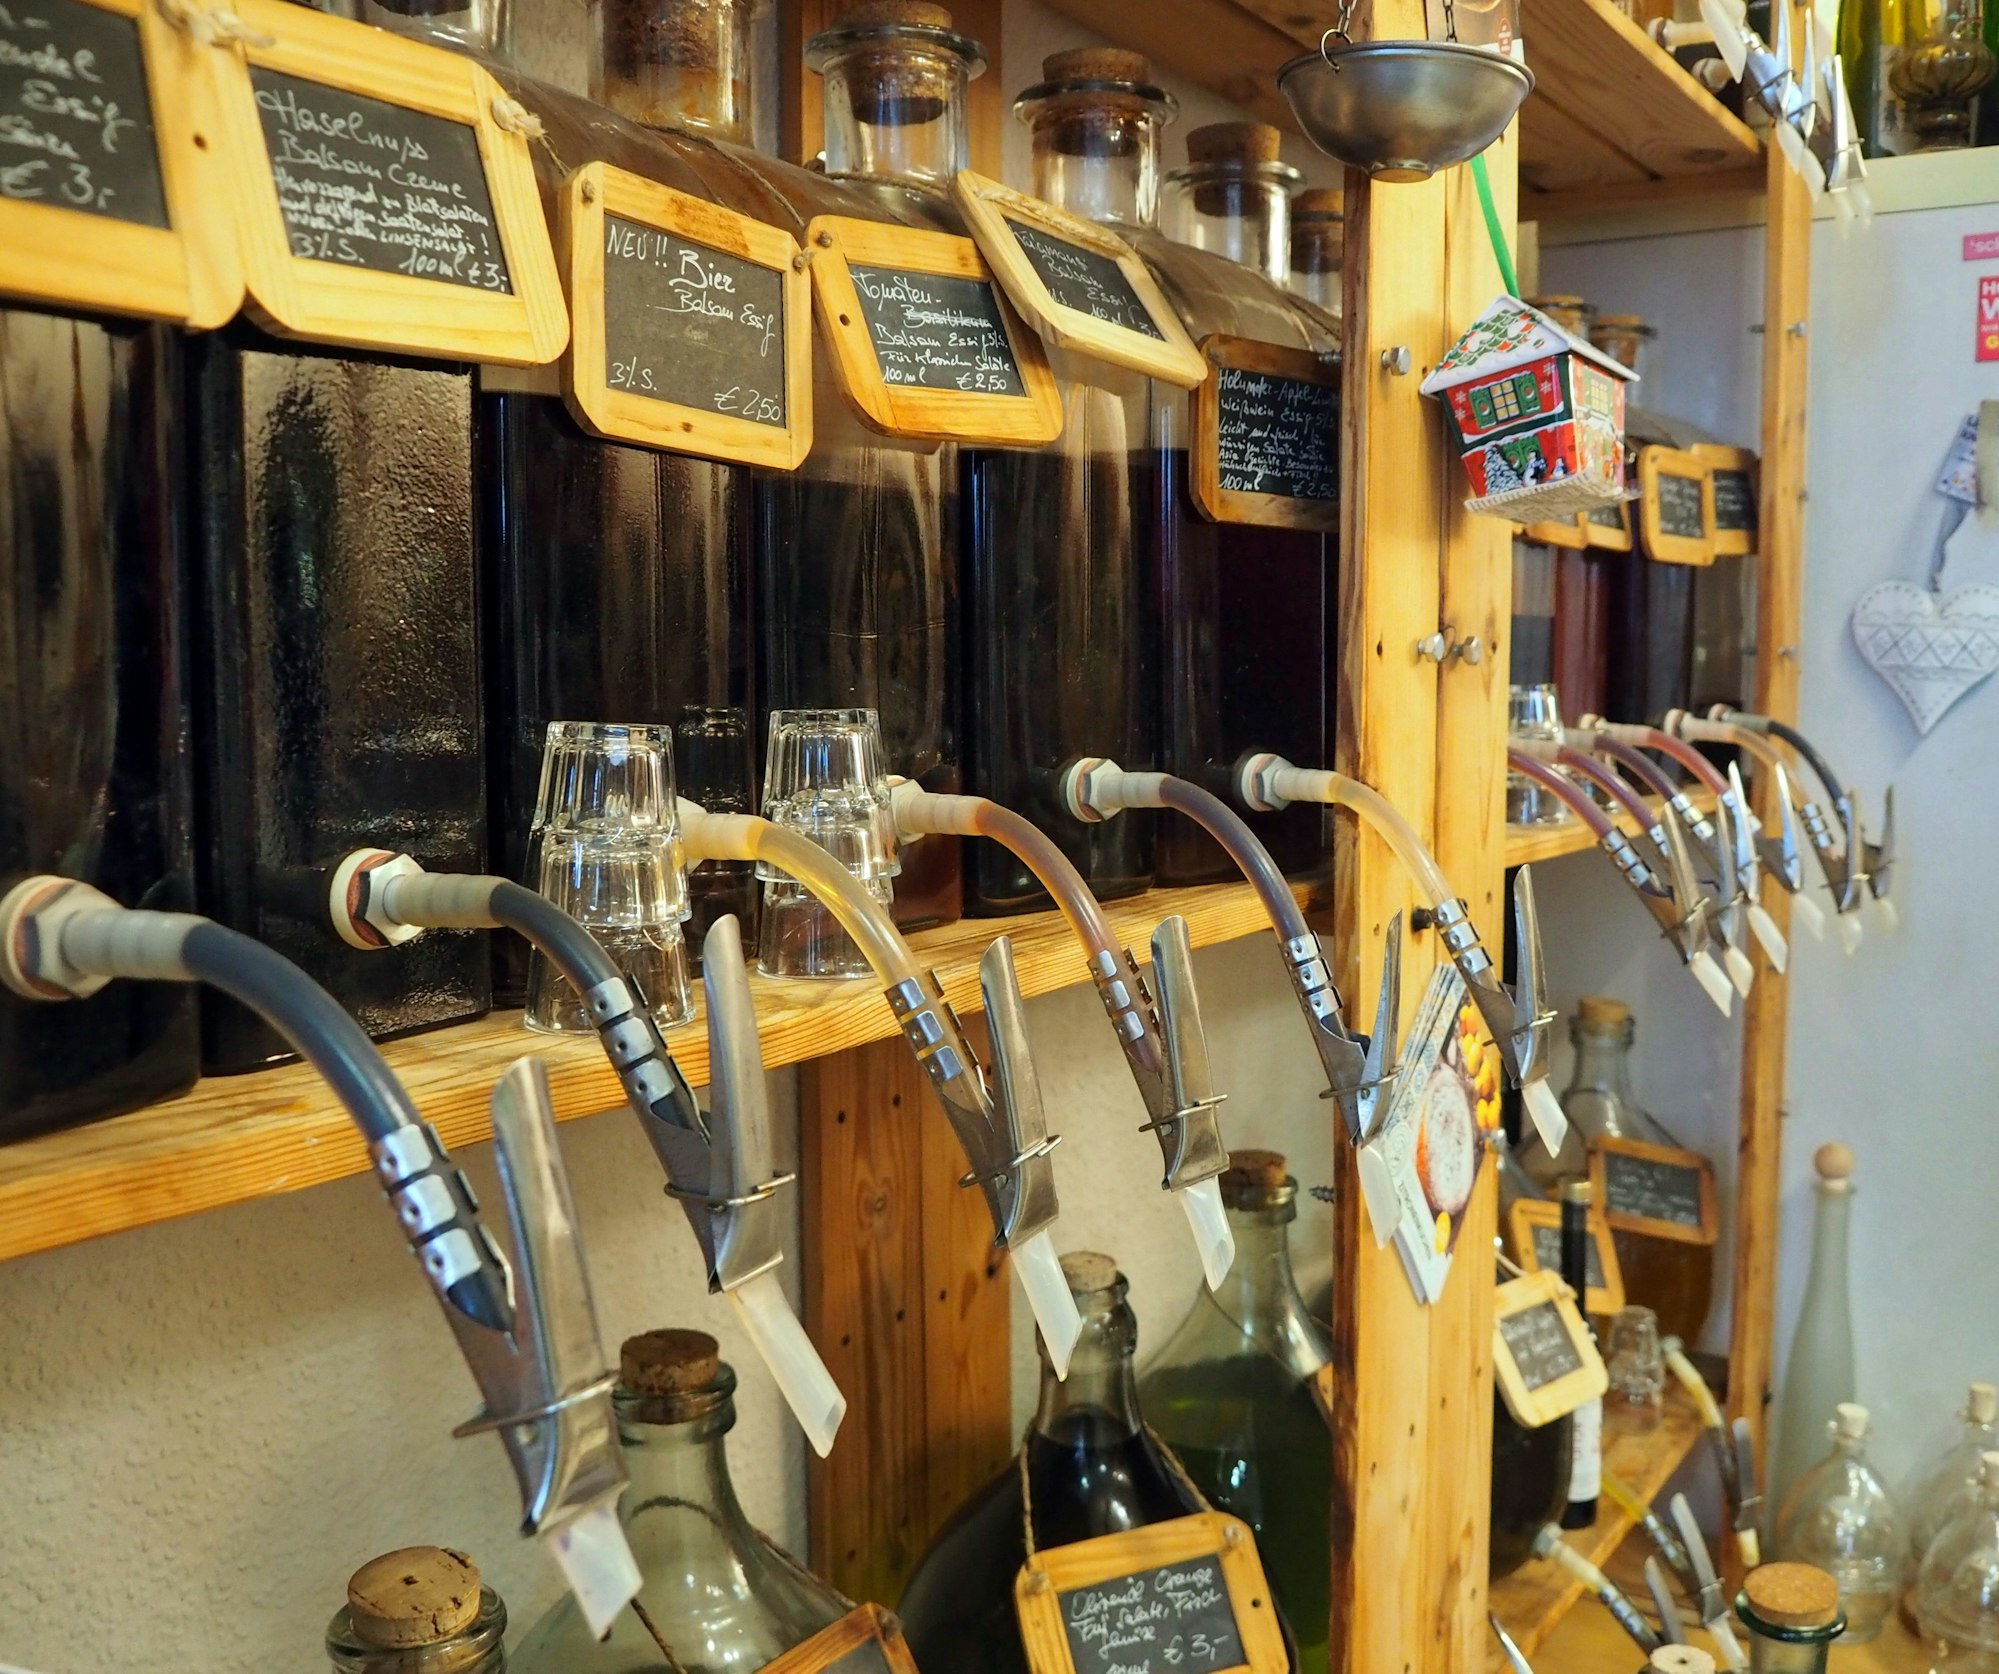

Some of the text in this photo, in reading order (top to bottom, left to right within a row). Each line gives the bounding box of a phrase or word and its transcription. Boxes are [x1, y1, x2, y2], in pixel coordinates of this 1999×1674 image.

[275, 129, 382, 180] Balsam
[669, 249, 736, 294] Bier
[658, 288, 734, 320] Balsam
[875, 323, 941, 348] Balsam
[955, 372, 973, 390] €
[975, 373, 1008, 391] 2,50
[1306, 483, 1337, 499] 2,50
